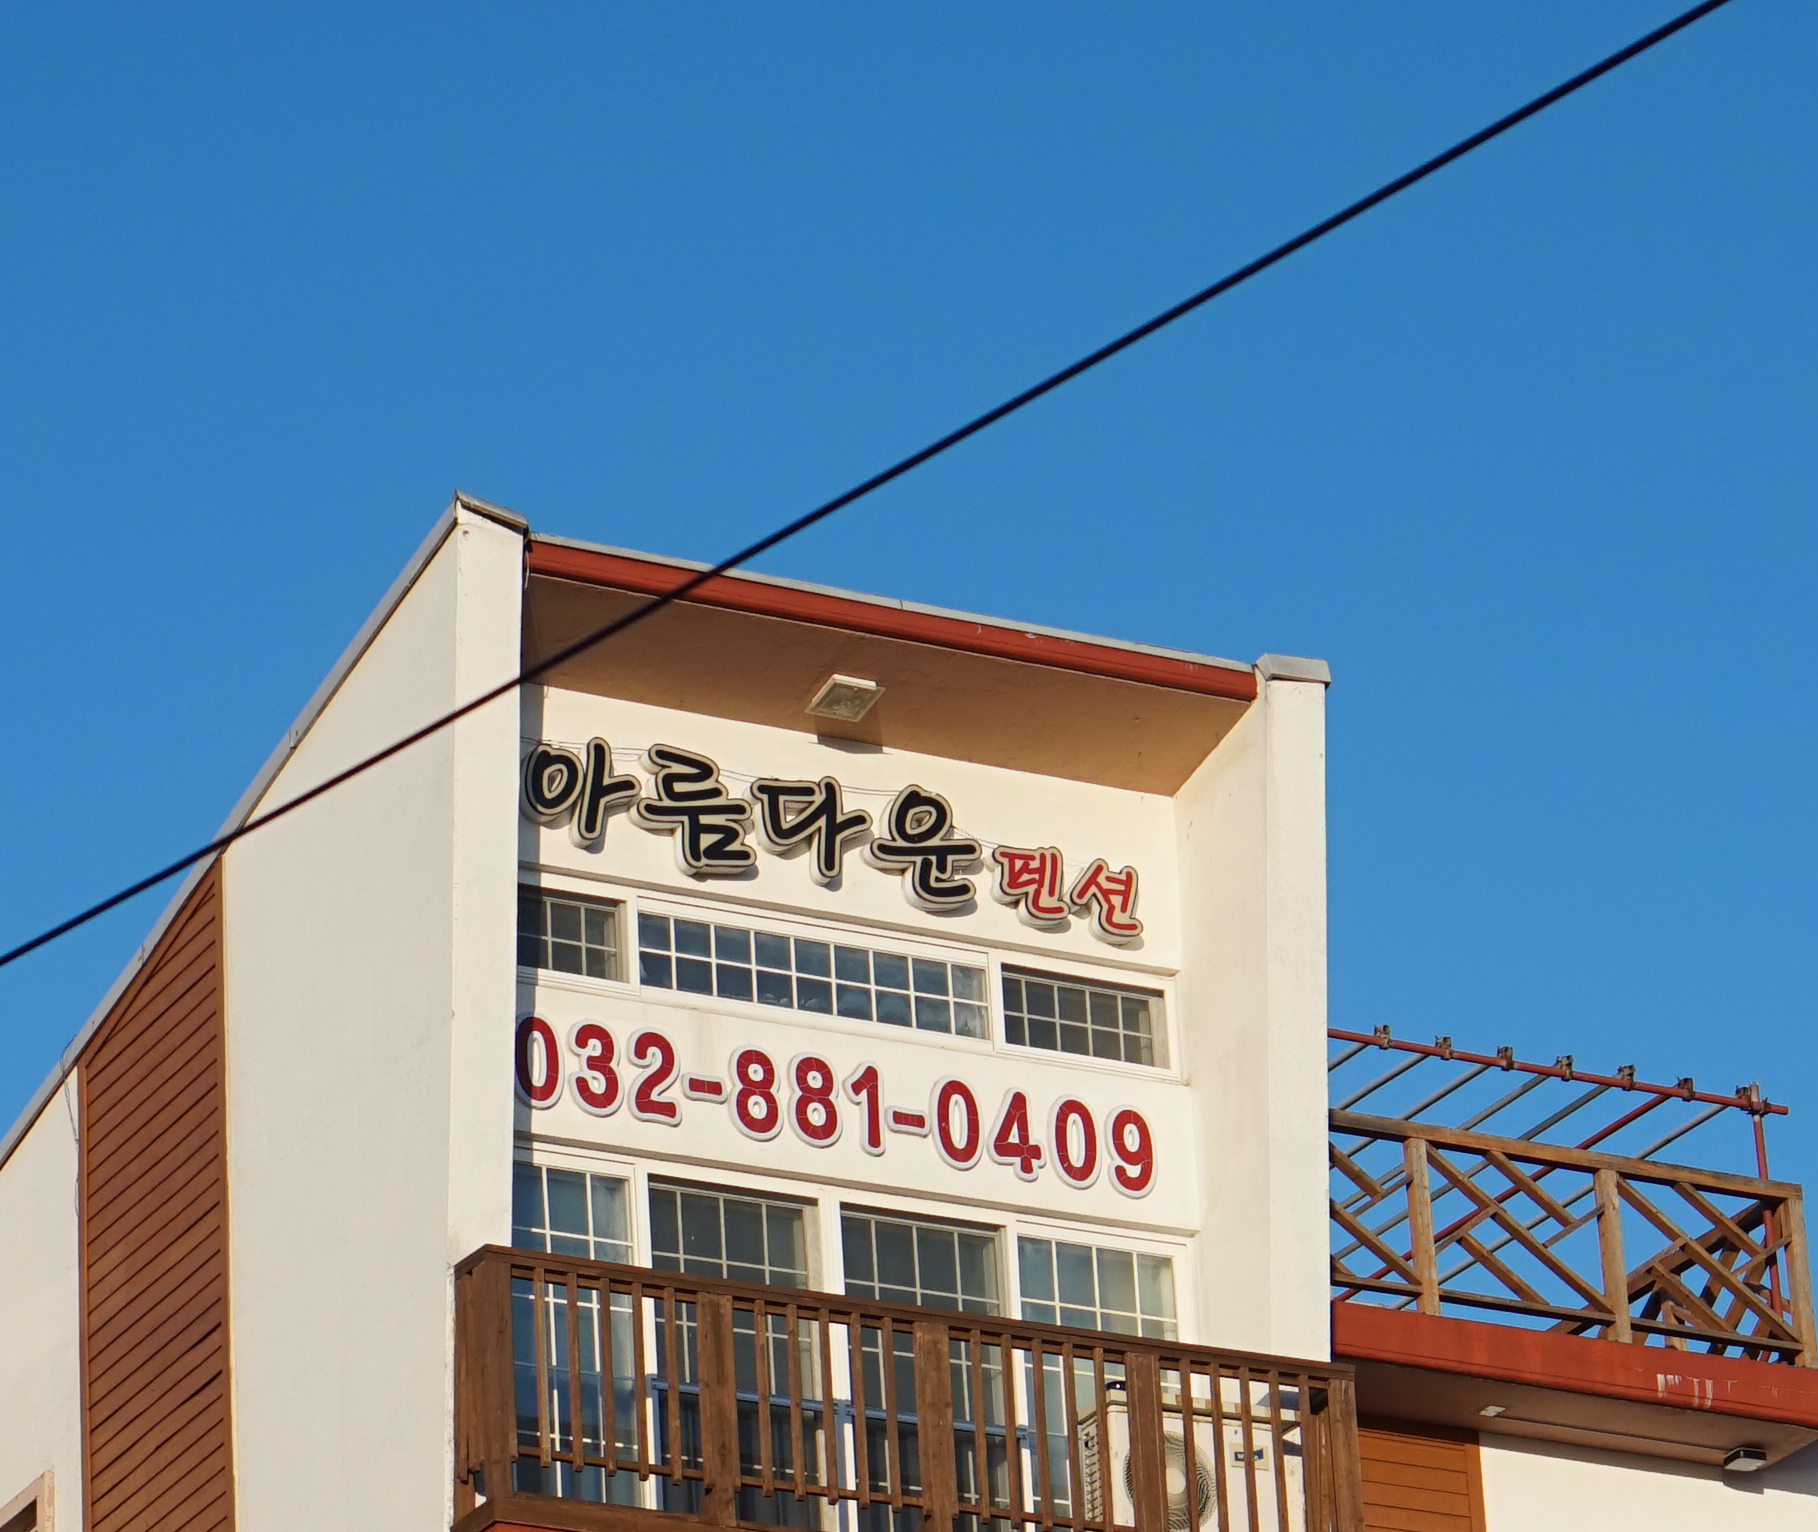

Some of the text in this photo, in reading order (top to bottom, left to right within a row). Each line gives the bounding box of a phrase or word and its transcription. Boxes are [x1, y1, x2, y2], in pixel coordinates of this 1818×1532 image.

[525, 737, 1144, 938] 아름다운 펜션
[514, 1014, 1156, 1194] 032-881-0409
